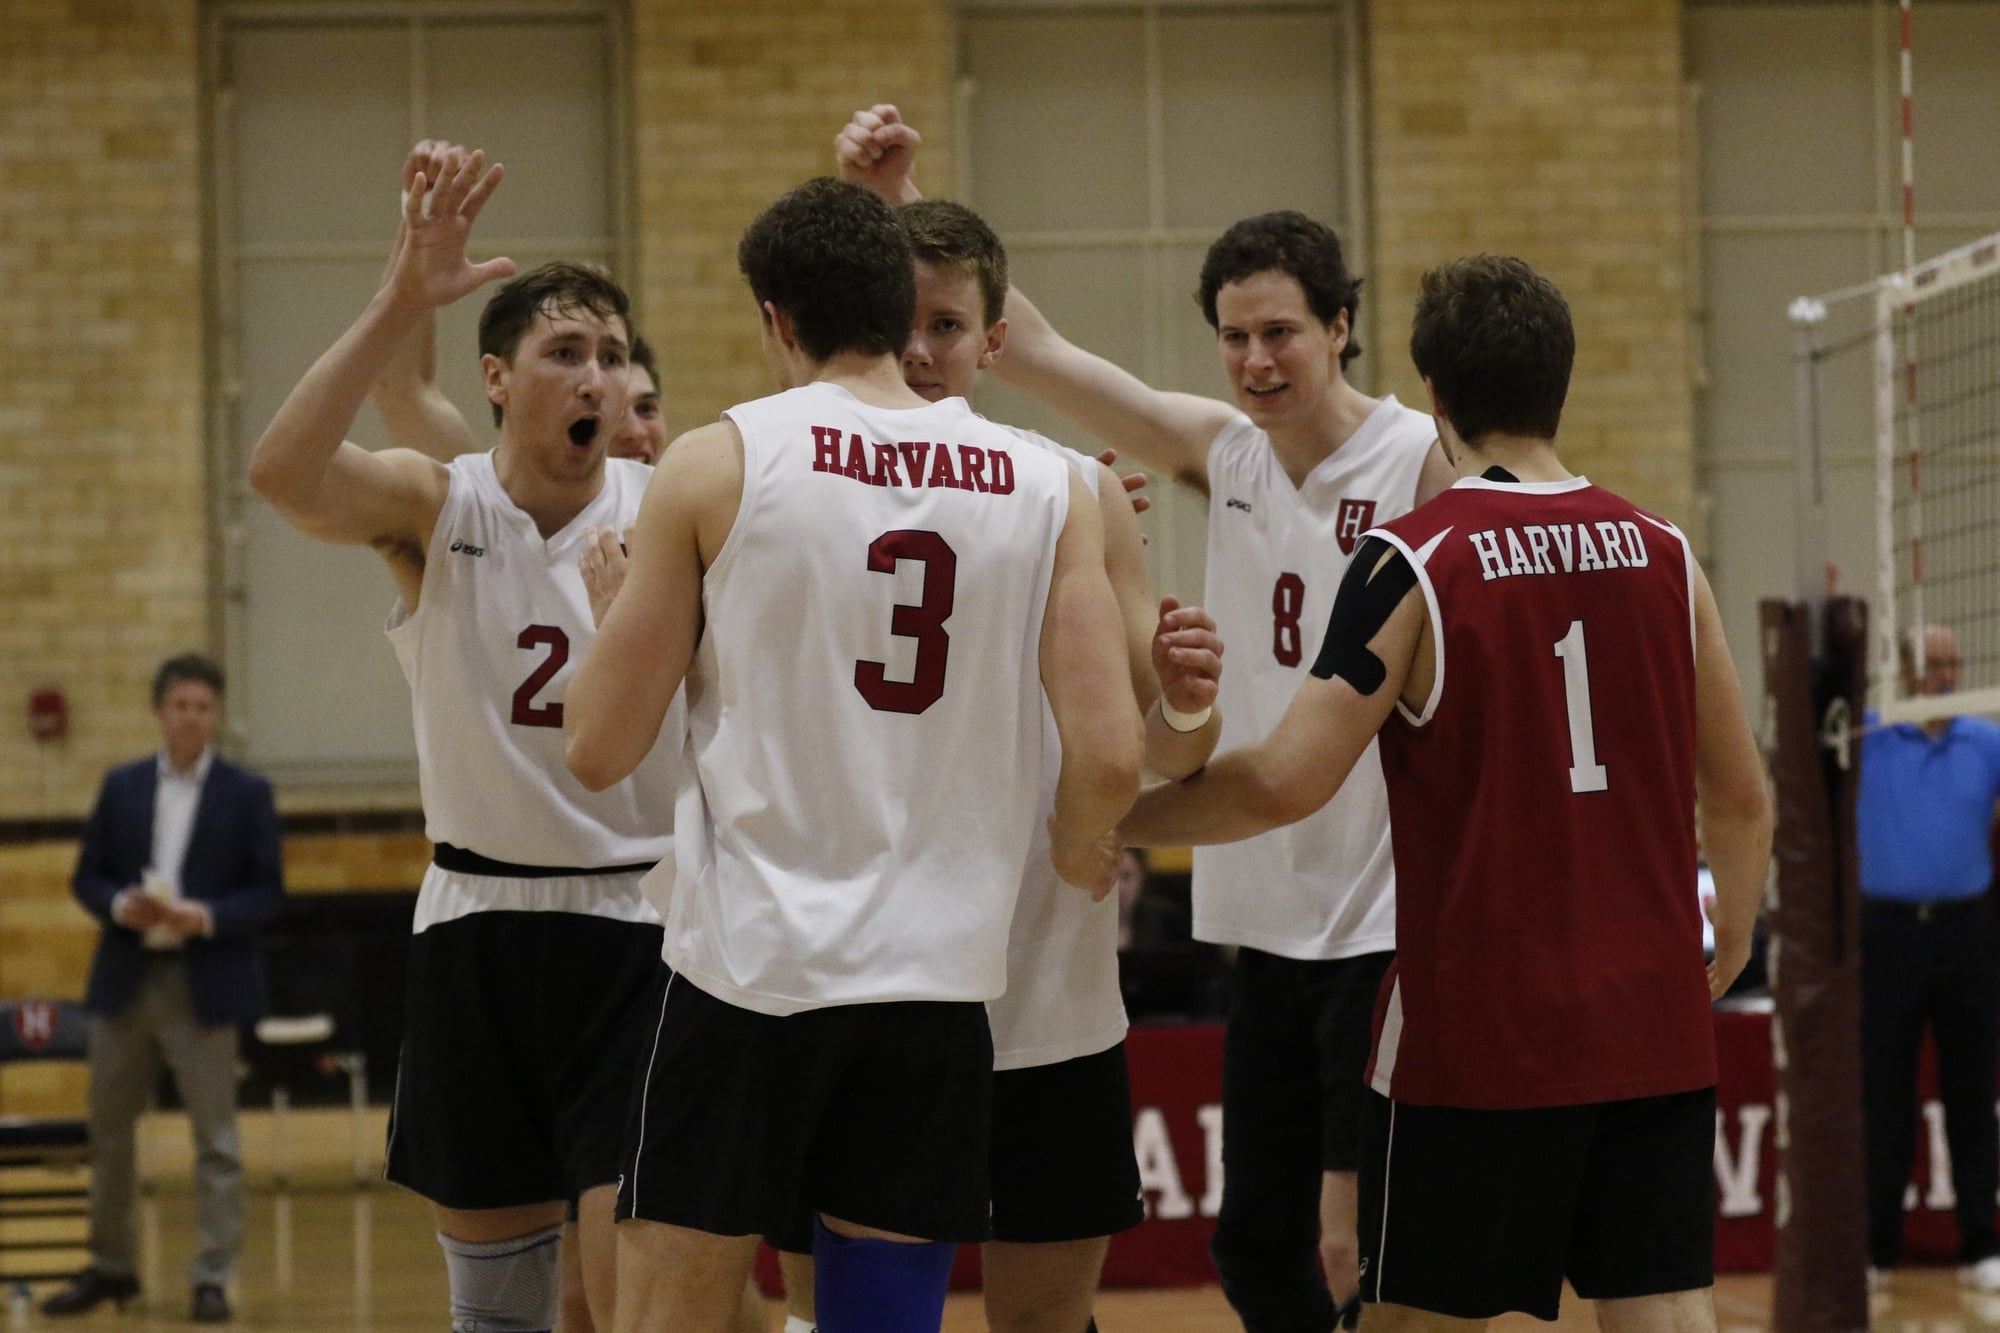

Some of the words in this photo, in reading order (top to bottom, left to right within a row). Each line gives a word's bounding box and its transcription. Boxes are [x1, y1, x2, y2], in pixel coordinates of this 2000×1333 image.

[811, 426, 1015, 495] HARVARD
[1340, 504, 1367, 539] H
[1468, 520, 1649, 581] HARVARD
[854, 529, 957, 715] 3
[1272, 571, 1306, 668] 8
[511, 624, 569, 728] 2
[1553, 619, 1608, 793] 1
